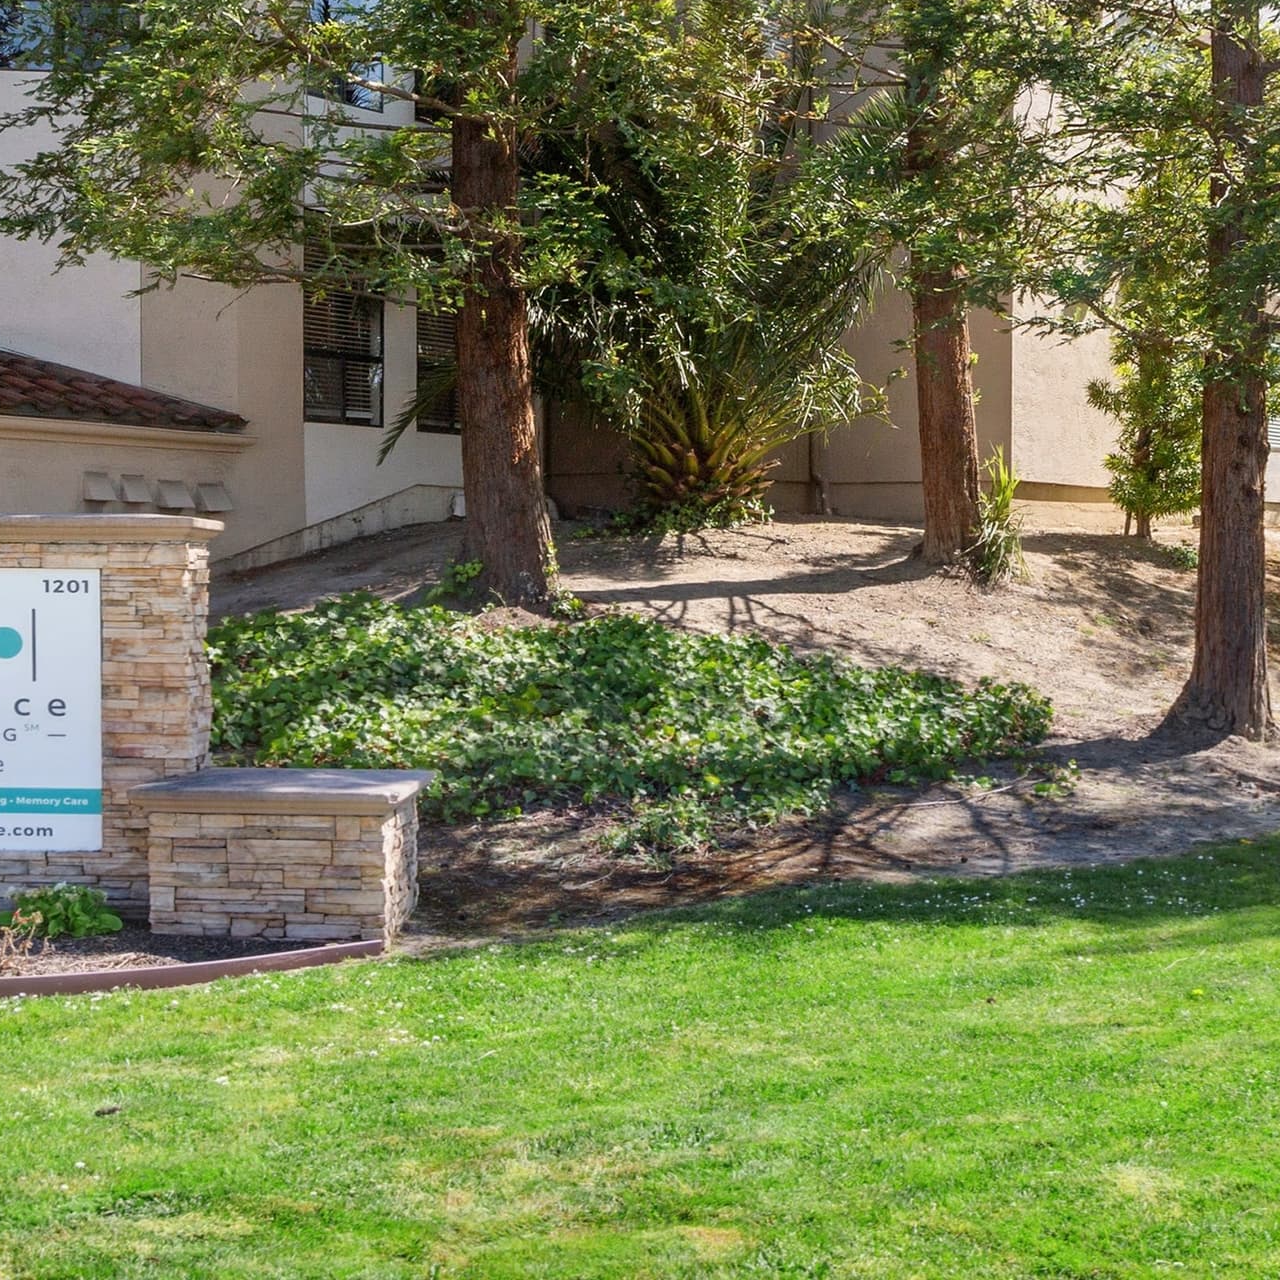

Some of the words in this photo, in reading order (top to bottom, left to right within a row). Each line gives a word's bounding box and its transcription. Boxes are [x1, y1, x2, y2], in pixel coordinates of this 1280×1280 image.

[42, 579, 90, 594] 1201
[16, 796, 61, 807] Memory
[63, 797, 89, 806] Care
